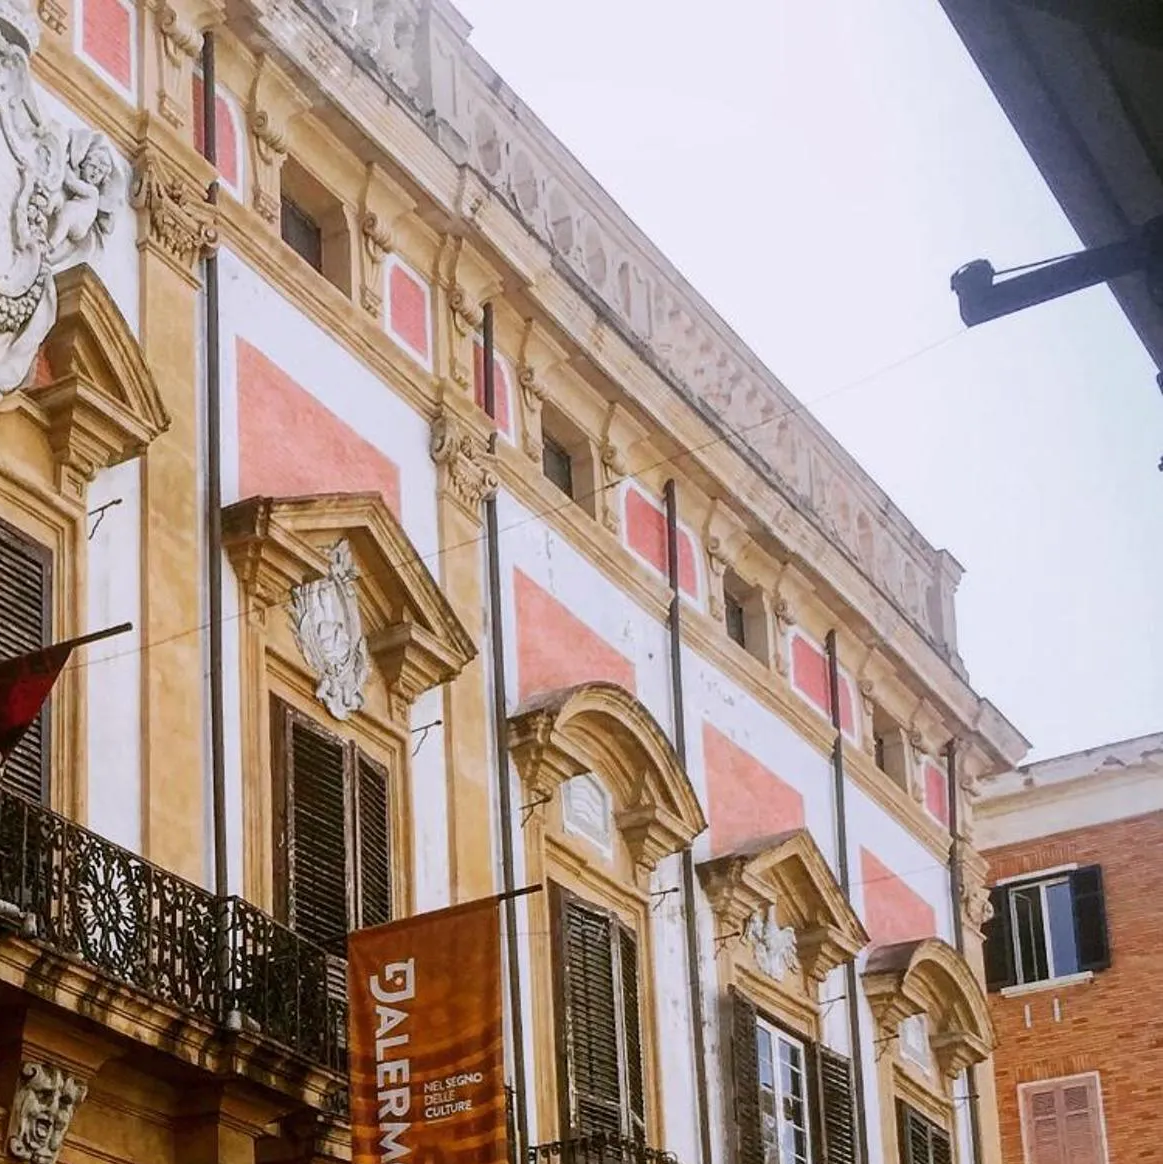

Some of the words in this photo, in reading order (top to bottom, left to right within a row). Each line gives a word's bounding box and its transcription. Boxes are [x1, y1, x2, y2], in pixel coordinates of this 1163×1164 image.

[424, 1080, 445, 1093] NEL
[445, 1072, 483, 1089] SEGNO
[424, 1090, 456, 1106] DELLE
[425, 1100, 473, 1118] CULTURE
